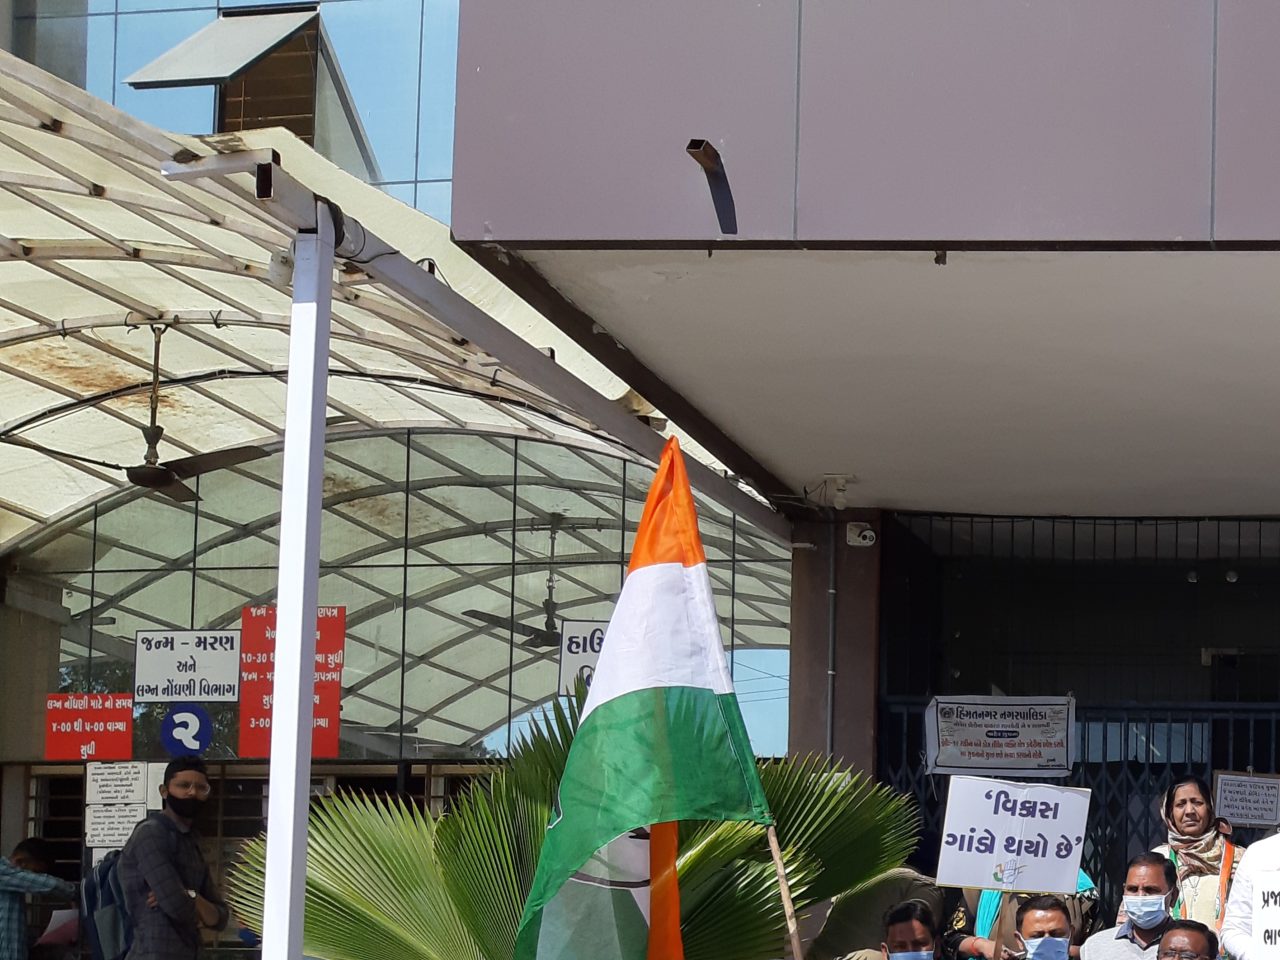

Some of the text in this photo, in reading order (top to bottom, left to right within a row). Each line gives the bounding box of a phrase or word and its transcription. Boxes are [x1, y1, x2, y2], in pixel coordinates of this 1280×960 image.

[141, 636, 175, 651] જન્મ
[195, 636, 235, 651] મરણ
[567, 628, 604, 654] હાઉ
[176, 655, 197, 673] અને
[327, 649, 343, 668] સુધી
[136, 678, 236, 697] લગ્ન નોંધણી વિભાગ
[955, 705, 998, 720] હિંમતનગર
[1000, 706, 1047, 720] નગરપાલિકા
[944, 827, 997, 854] ગાંડો
[1003, 832, 1049, 858] થયો
